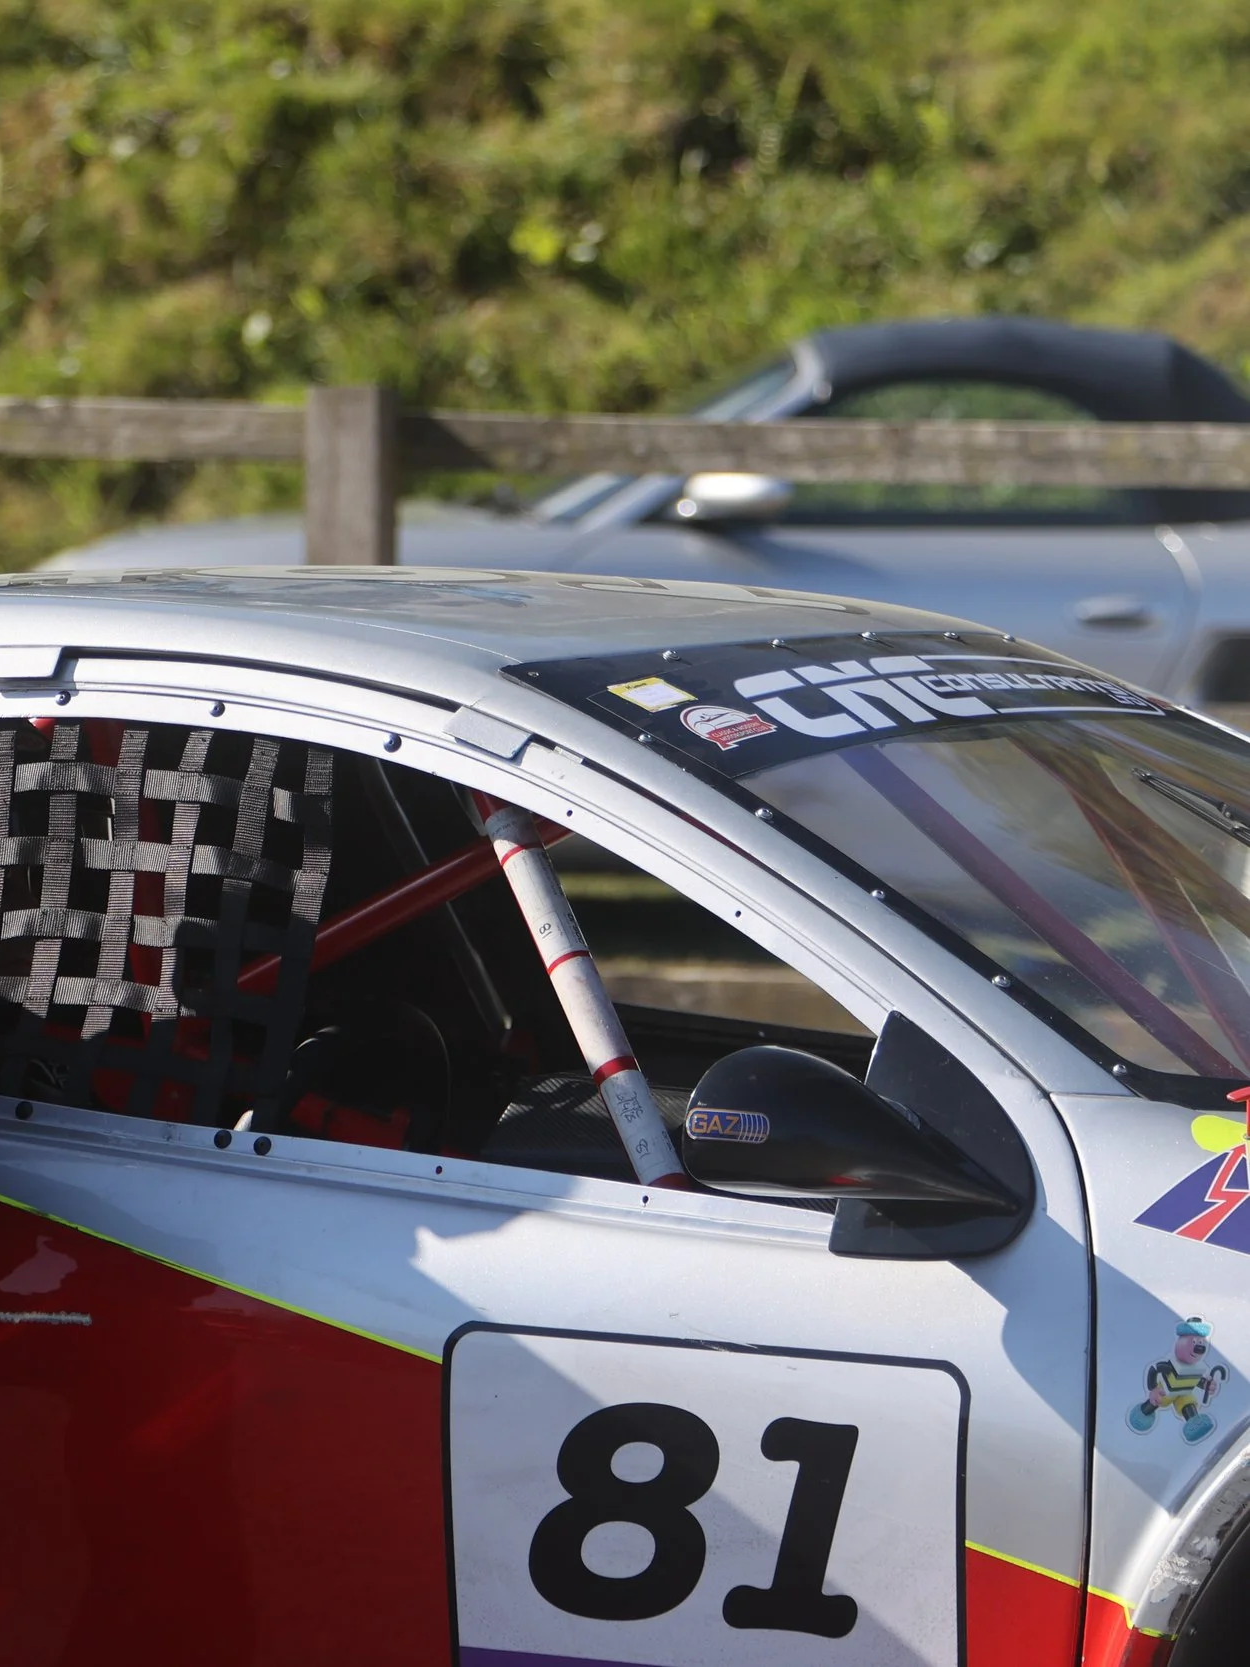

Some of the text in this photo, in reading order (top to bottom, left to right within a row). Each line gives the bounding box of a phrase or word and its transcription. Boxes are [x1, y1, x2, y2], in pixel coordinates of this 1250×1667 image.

[733, 655, 998, 738] CNC
[691, 1113, 740, 1135] GAZ
[528, 1402, 859, 1639] 81
